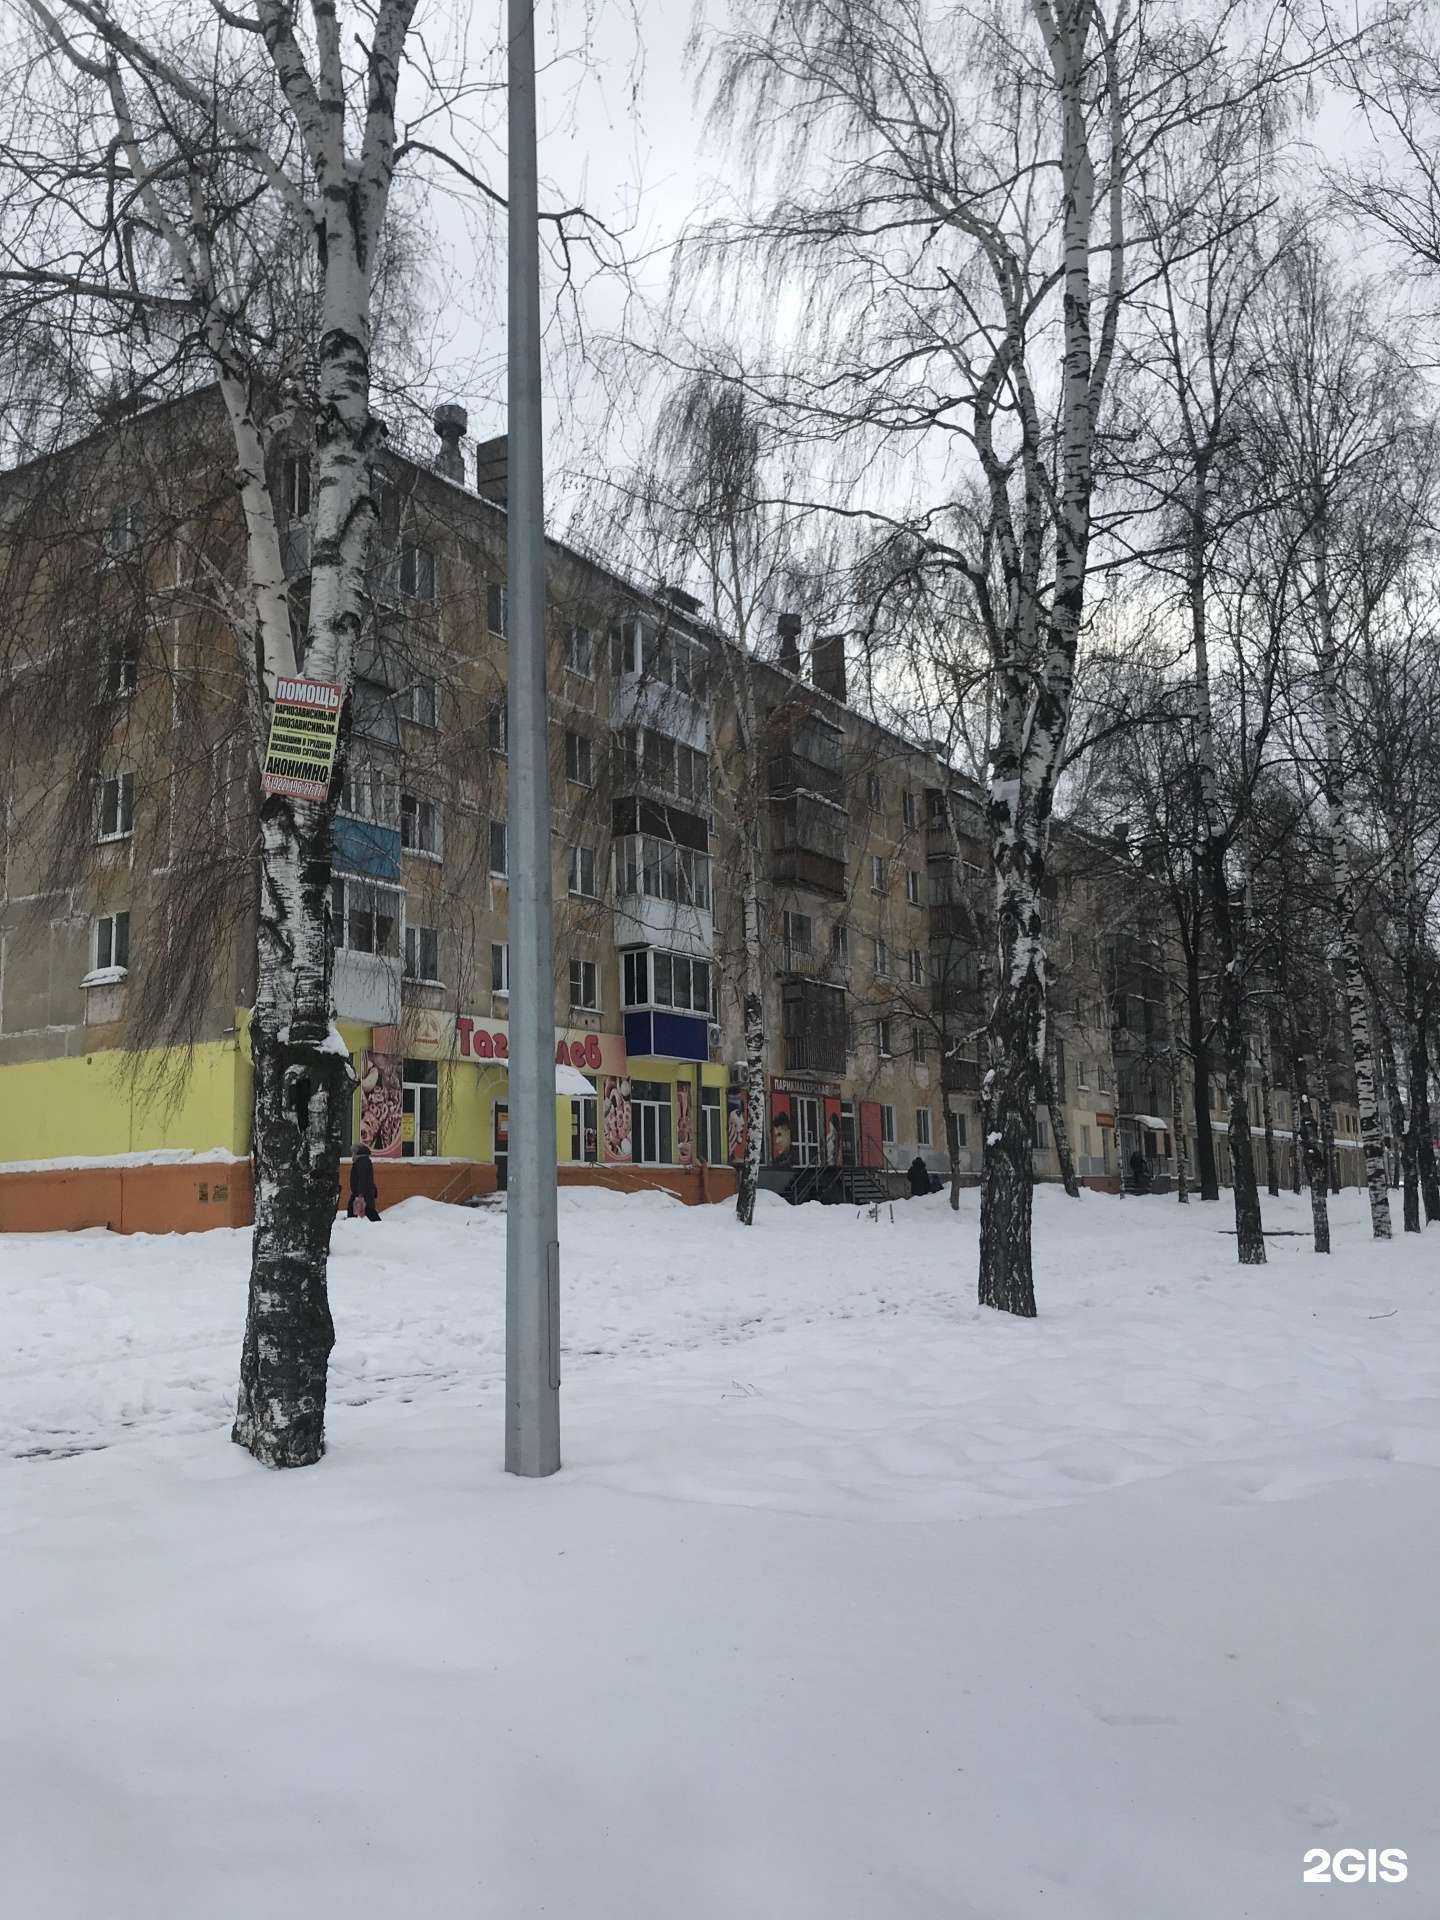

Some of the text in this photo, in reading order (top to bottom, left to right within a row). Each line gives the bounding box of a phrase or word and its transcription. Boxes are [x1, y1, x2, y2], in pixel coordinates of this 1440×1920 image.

[277, 681, 339, 707] ПОМОЩЬ
[265, 756, 329, 783] АНОНИМНО
[456, 1017, 602, 1069] Таглеб
